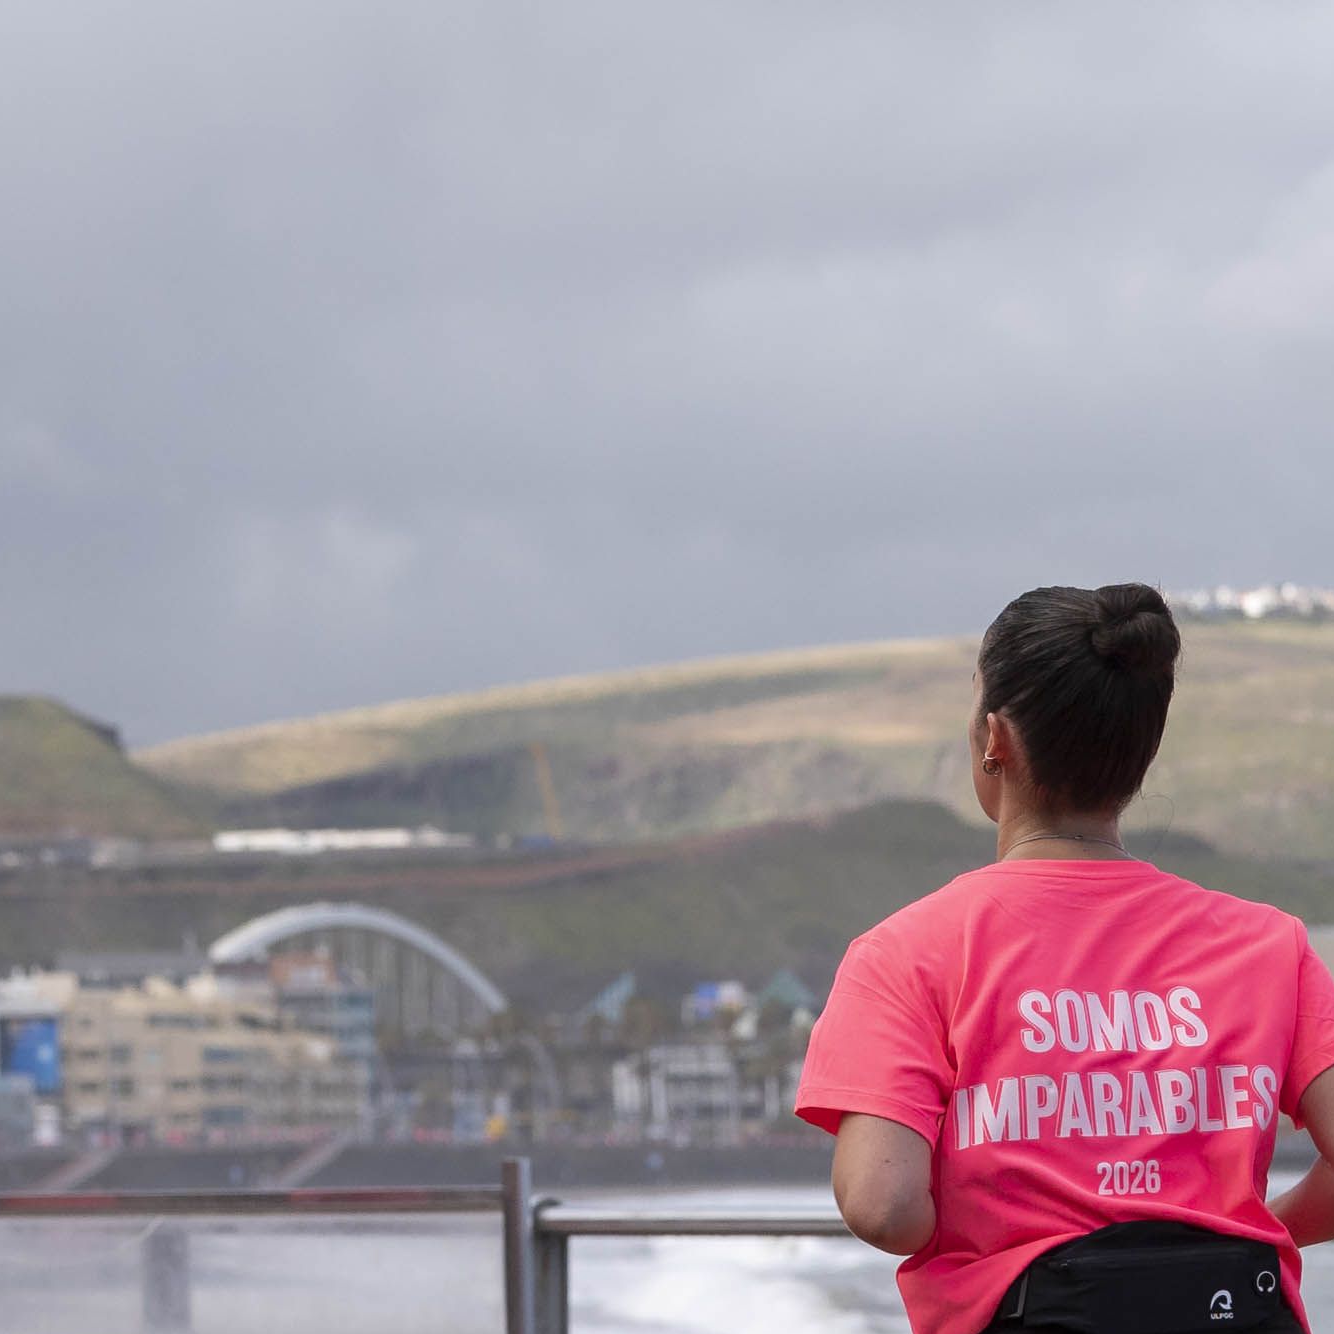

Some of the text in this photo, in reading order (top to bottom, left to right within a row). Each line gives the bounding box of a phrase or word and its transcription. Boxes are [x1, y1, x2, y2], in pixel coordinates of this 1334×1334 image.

[1018, 986, 1209, 1053] SOMOS
[954, 1064, 1278, 1150] IMPARABLES
[1097, 1159, 1162, 1196] 2026
